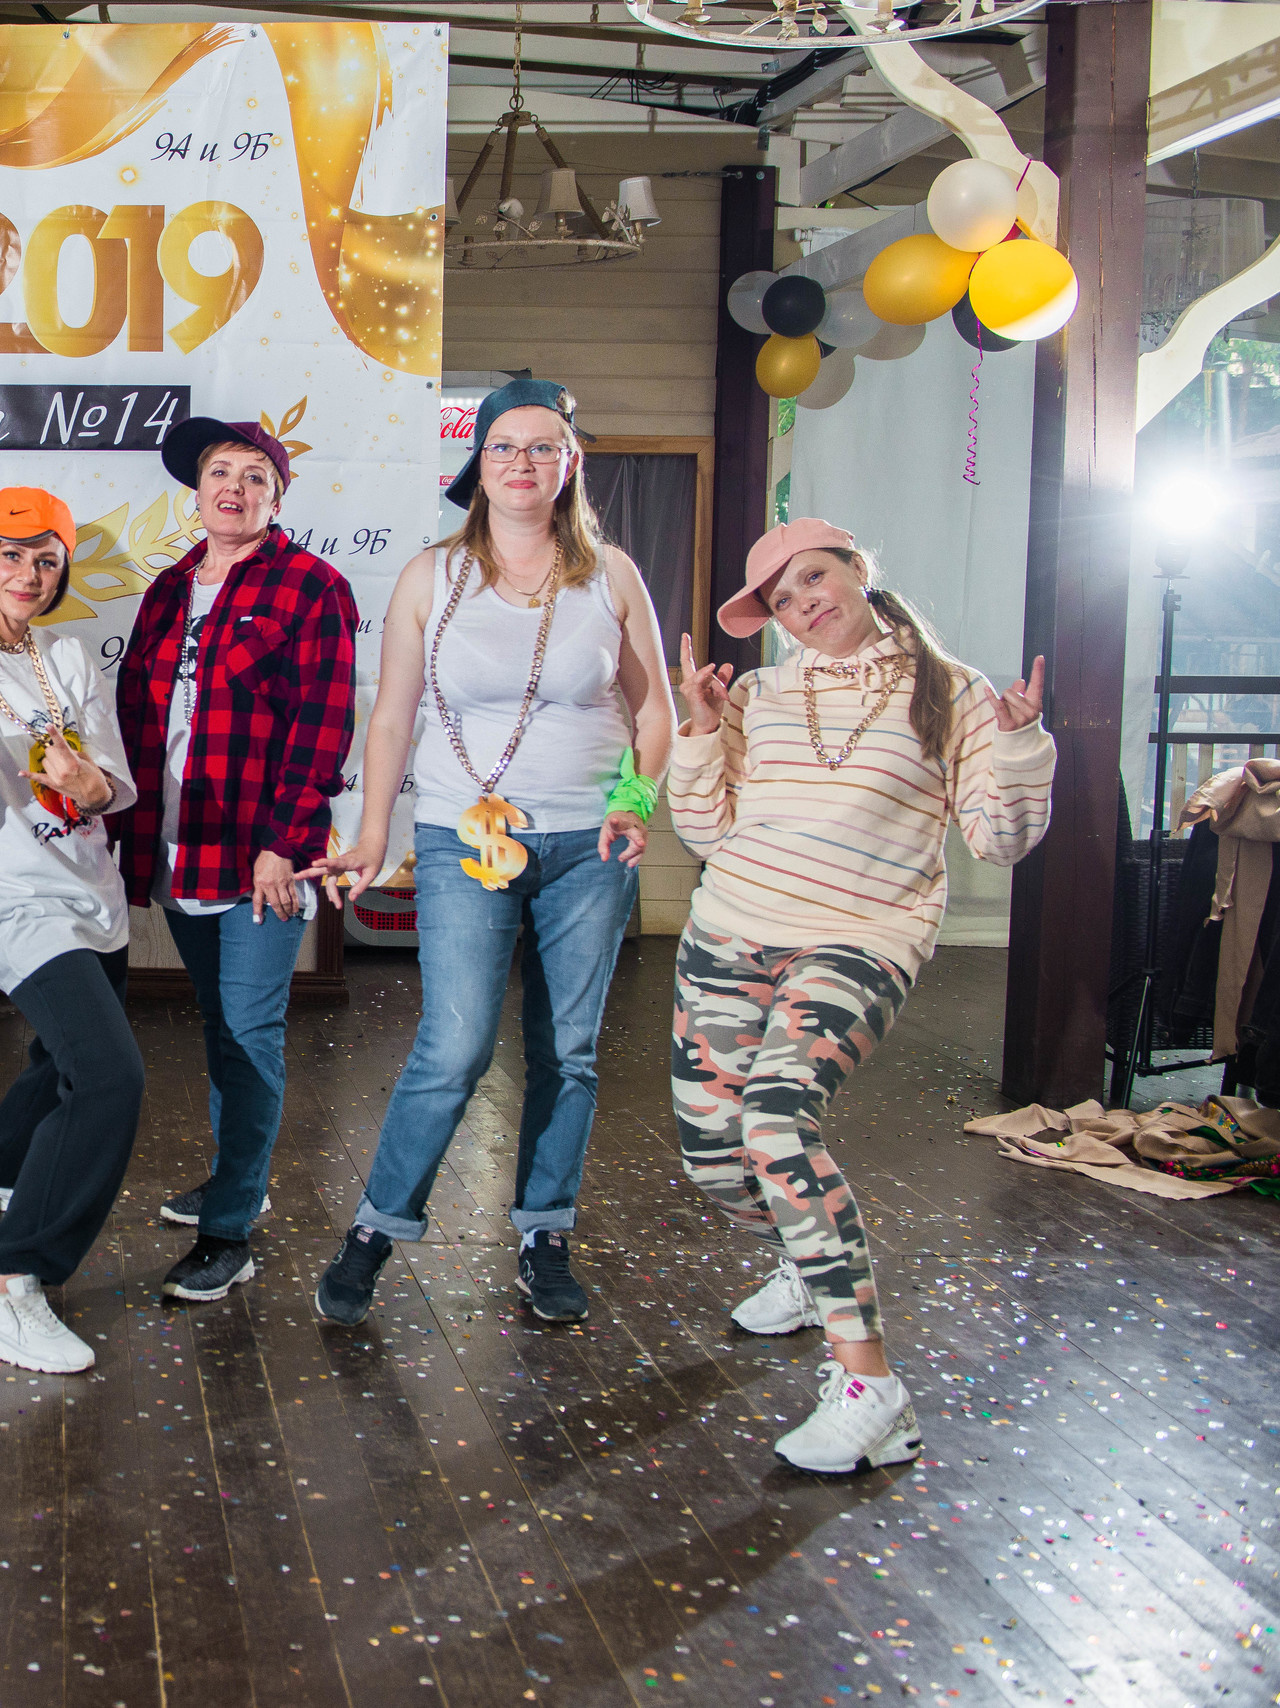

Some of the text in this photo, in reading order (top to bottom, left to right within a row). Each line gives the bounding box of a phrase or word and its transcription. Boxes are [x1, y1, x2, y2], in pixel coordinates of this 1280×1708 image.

[150, 132, 273, 162] 9А и 9Б
[320, 537, 340, 555] и
[348, 528, 392, 555] 9Б
